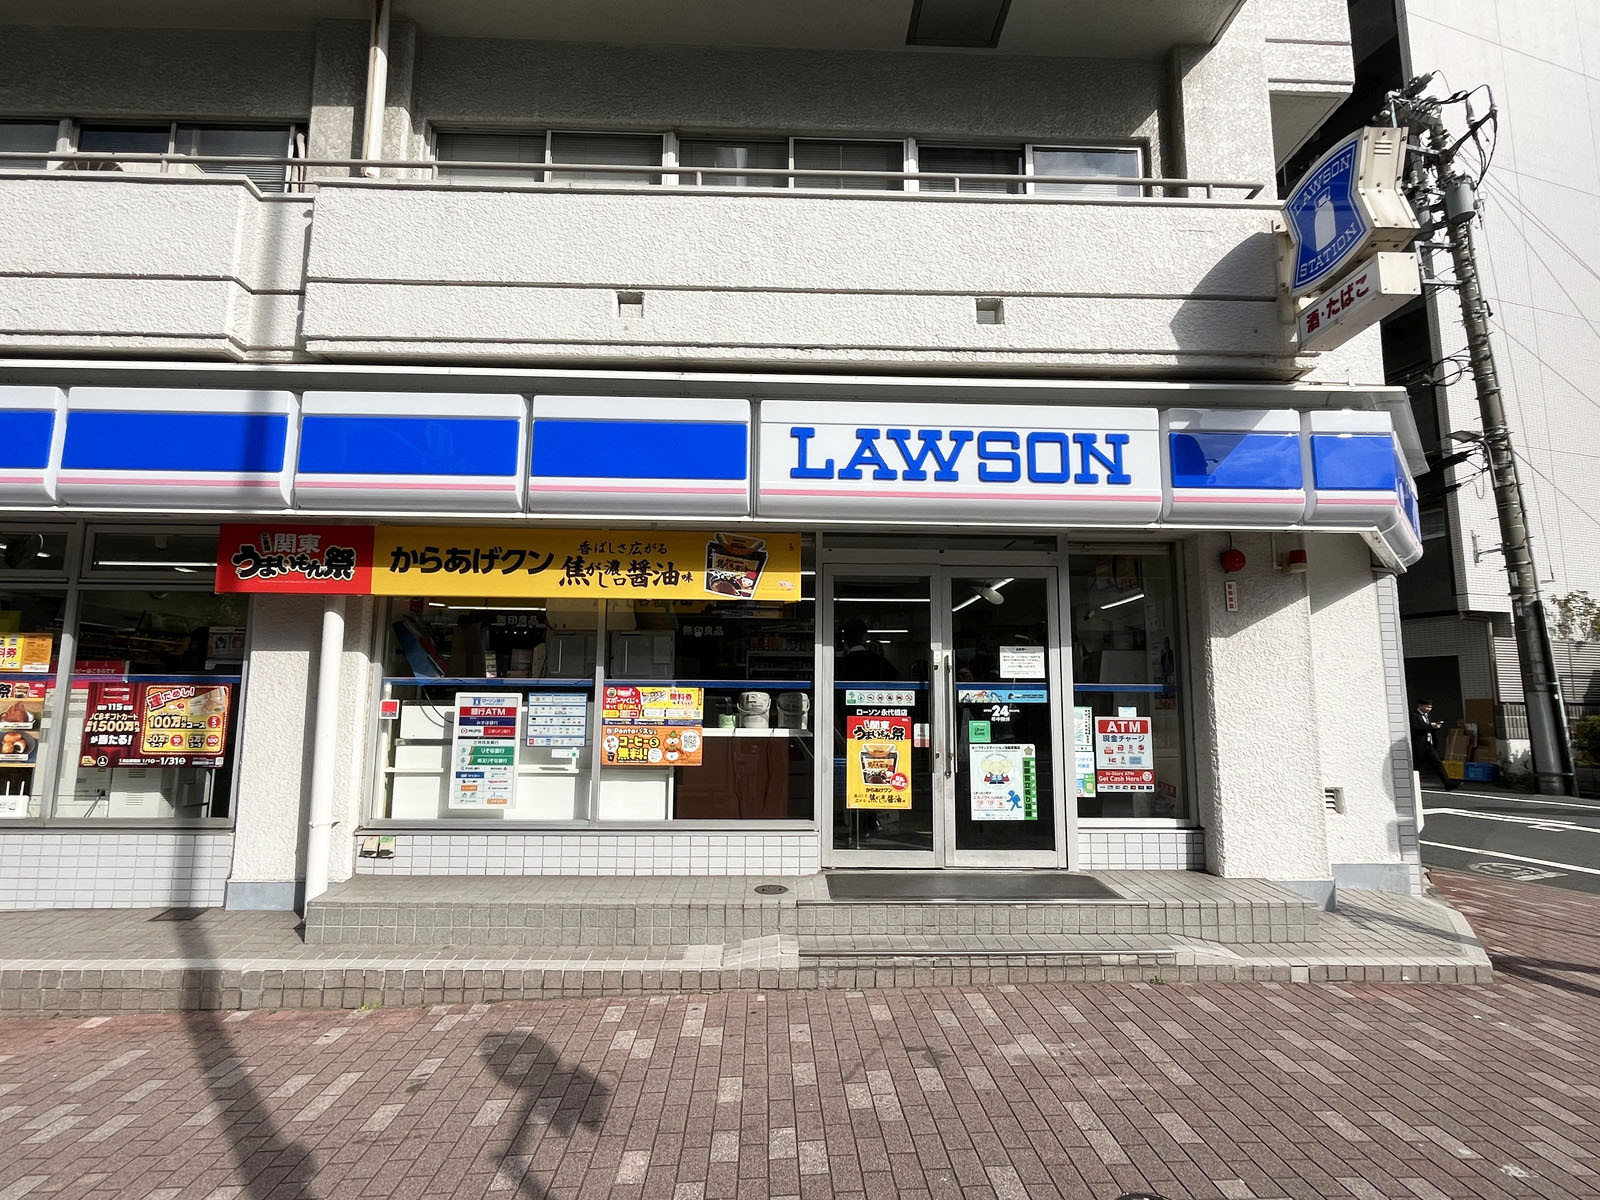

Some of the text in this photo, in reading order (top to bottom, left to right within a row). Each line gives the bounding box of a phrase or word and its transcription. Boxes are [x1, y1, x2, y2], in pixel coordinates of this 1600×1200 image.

[1293, 153, 1351, 216] LAWSON
[1300, 222, 1357, 277] STATION
[790, 427, 1131, 485] LAWSON
[274, 533, 321, 553] 関東
[578, 540, 668, 555] 香ばしさ広がる
[231, 544, 356, 580] うまいもん祭
[389, 546, 554, 575] からあげクン
[992, 705, 1010, 716] 24
[1107, 721, 1140, 733] ATM
